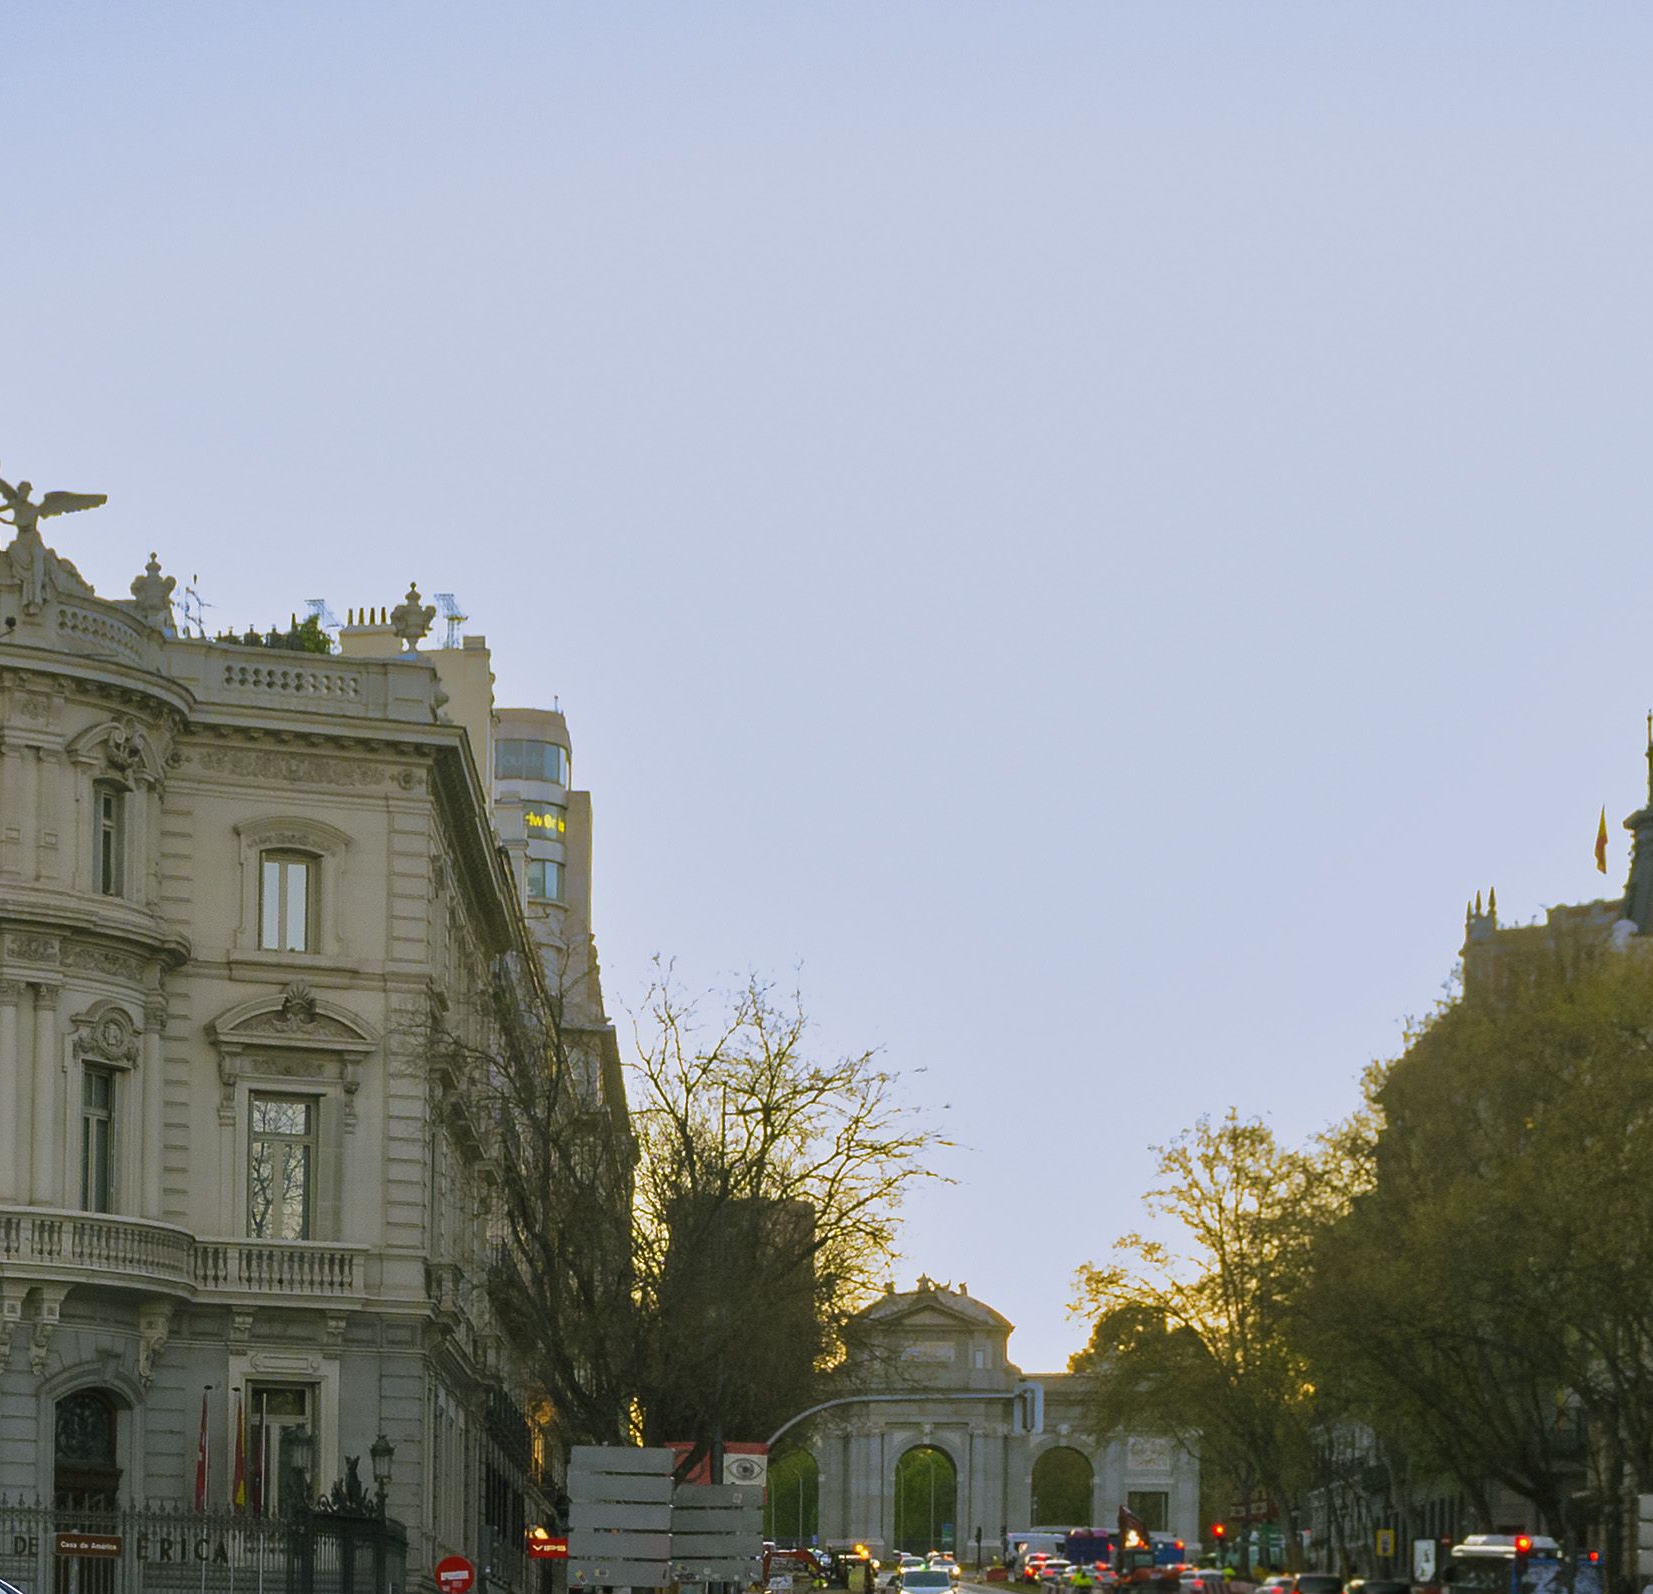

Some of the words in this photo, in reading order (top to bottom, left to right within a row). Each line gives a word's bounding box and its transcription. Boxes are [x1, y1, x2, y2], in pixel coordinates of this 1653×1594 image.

[60, 1541, 77, 1549] Casa
[79, 1541, 89, 1549] de
[532, 1544, 566, 1552] VIPS
